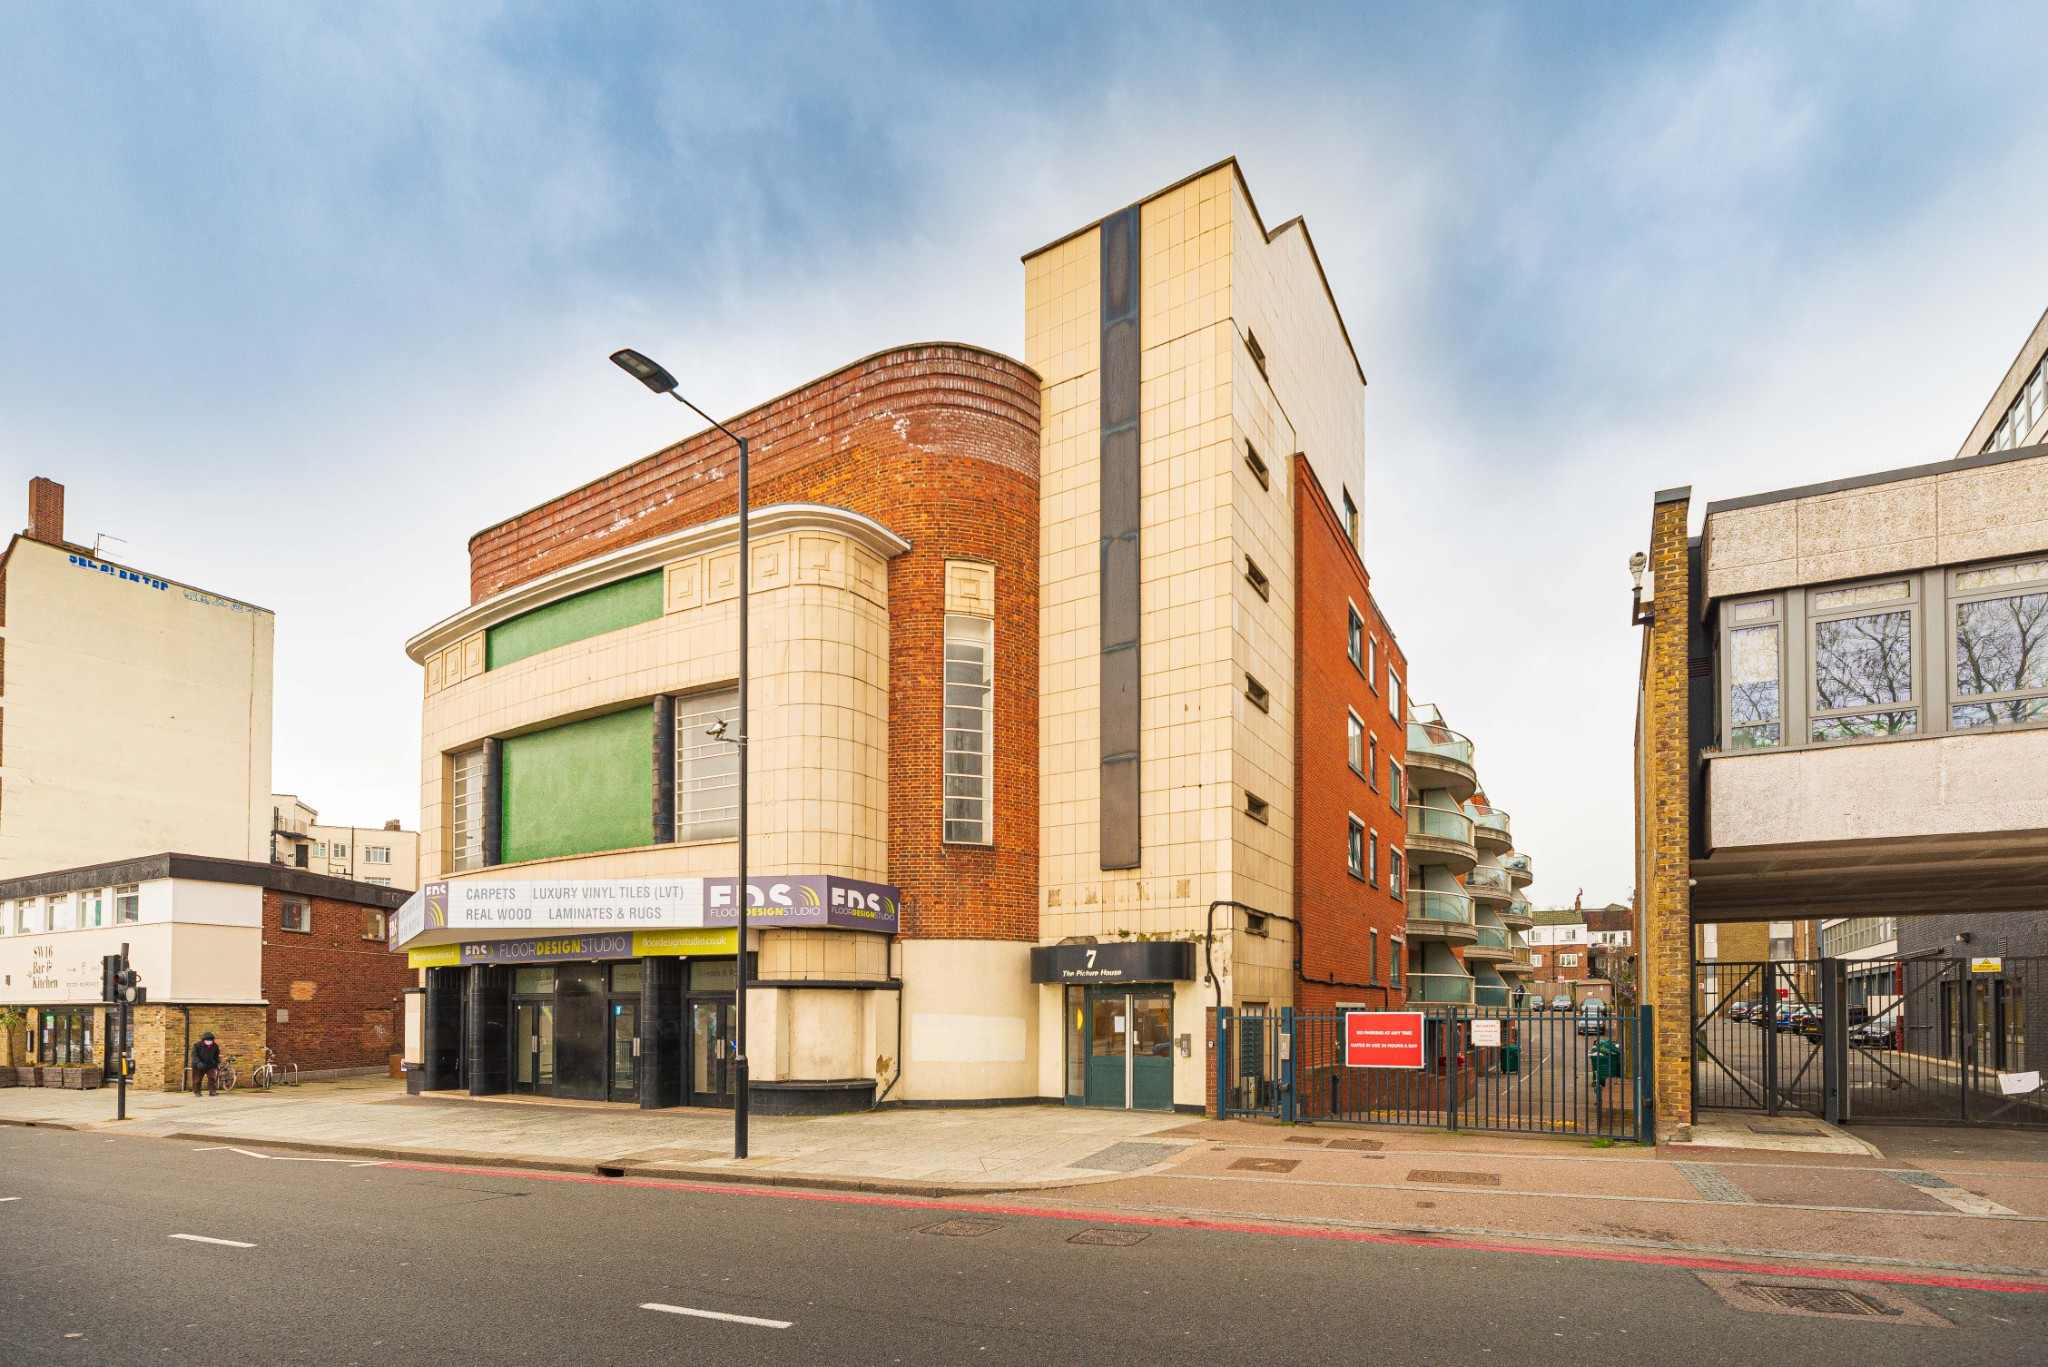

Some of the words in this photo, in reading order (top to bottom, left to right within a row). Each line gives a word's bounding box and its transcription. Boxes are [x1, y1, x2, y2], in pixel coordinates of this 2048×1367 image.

[466, 888, 516, 900] CARPETS
[533, 887, 578, 899] LUXURY
[582, 886, 616, 899] VINYL
[619, 886, 651, 899] TILES
[654, 885, 684, 900] (LVT)
[710, 884, 793, 907] FDS
[831, 887, 881, 912] FDS
[466, 908, 494, 920] REAL
[497, 908, 532, 920] WOOD
[549, 907, 613, 920] LAMINATES
[617, 907, 625, 919] &
[629, 907, 662, 919] RUGS
[642, 936, 726, 948] floordesignstudio.co.uk
[33, 945, 53, 958] SW16
[1085, 949, 1097, 969] 7
[33, 961, 45, 974] Bar
[1076, 969, 1099, 977] Picture
[32, 976, 58, 989] Kitchen
